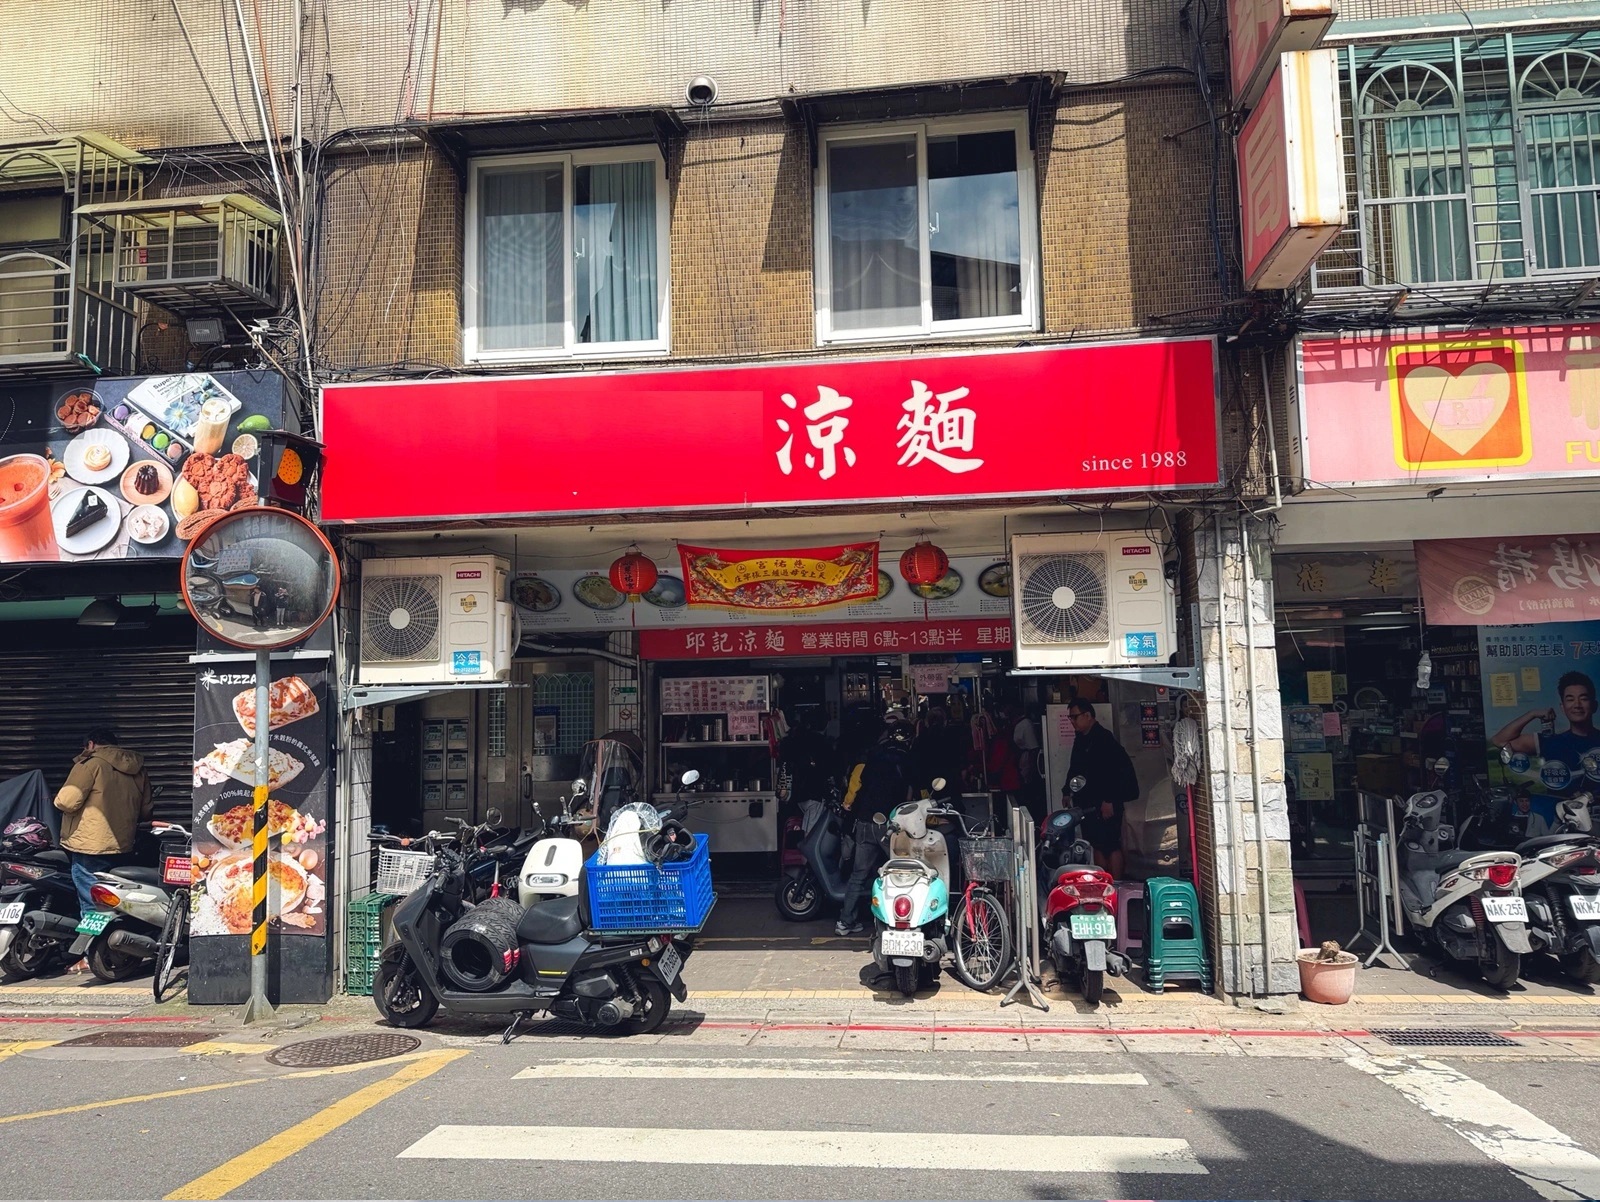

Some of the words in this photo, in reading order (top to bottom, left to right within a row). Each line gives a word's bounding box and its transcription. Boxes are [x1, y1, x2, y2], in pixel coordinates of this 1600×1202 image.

[776, 379, 985, 480] 涼麵
[1082, 453, 1133, 472] since
[1141, 450, 1187, 469] 1988
[1565, 441, 1600, 464] FU
[685, 628, 786, 655] 邱記涼麵
[801, 630, 868, 649] 營業時間
[873, 628, 964, 648] 6點~13點半
[976, 626, 1012, 645] 星期
[1128, 635, 1156, 648] 冷氣
[456, 652, 480, 666] 冷氣
[1486, 643, 1565, 657] 幫助肌肉生長
[1072, 923, 1114, 935] EHH-917
